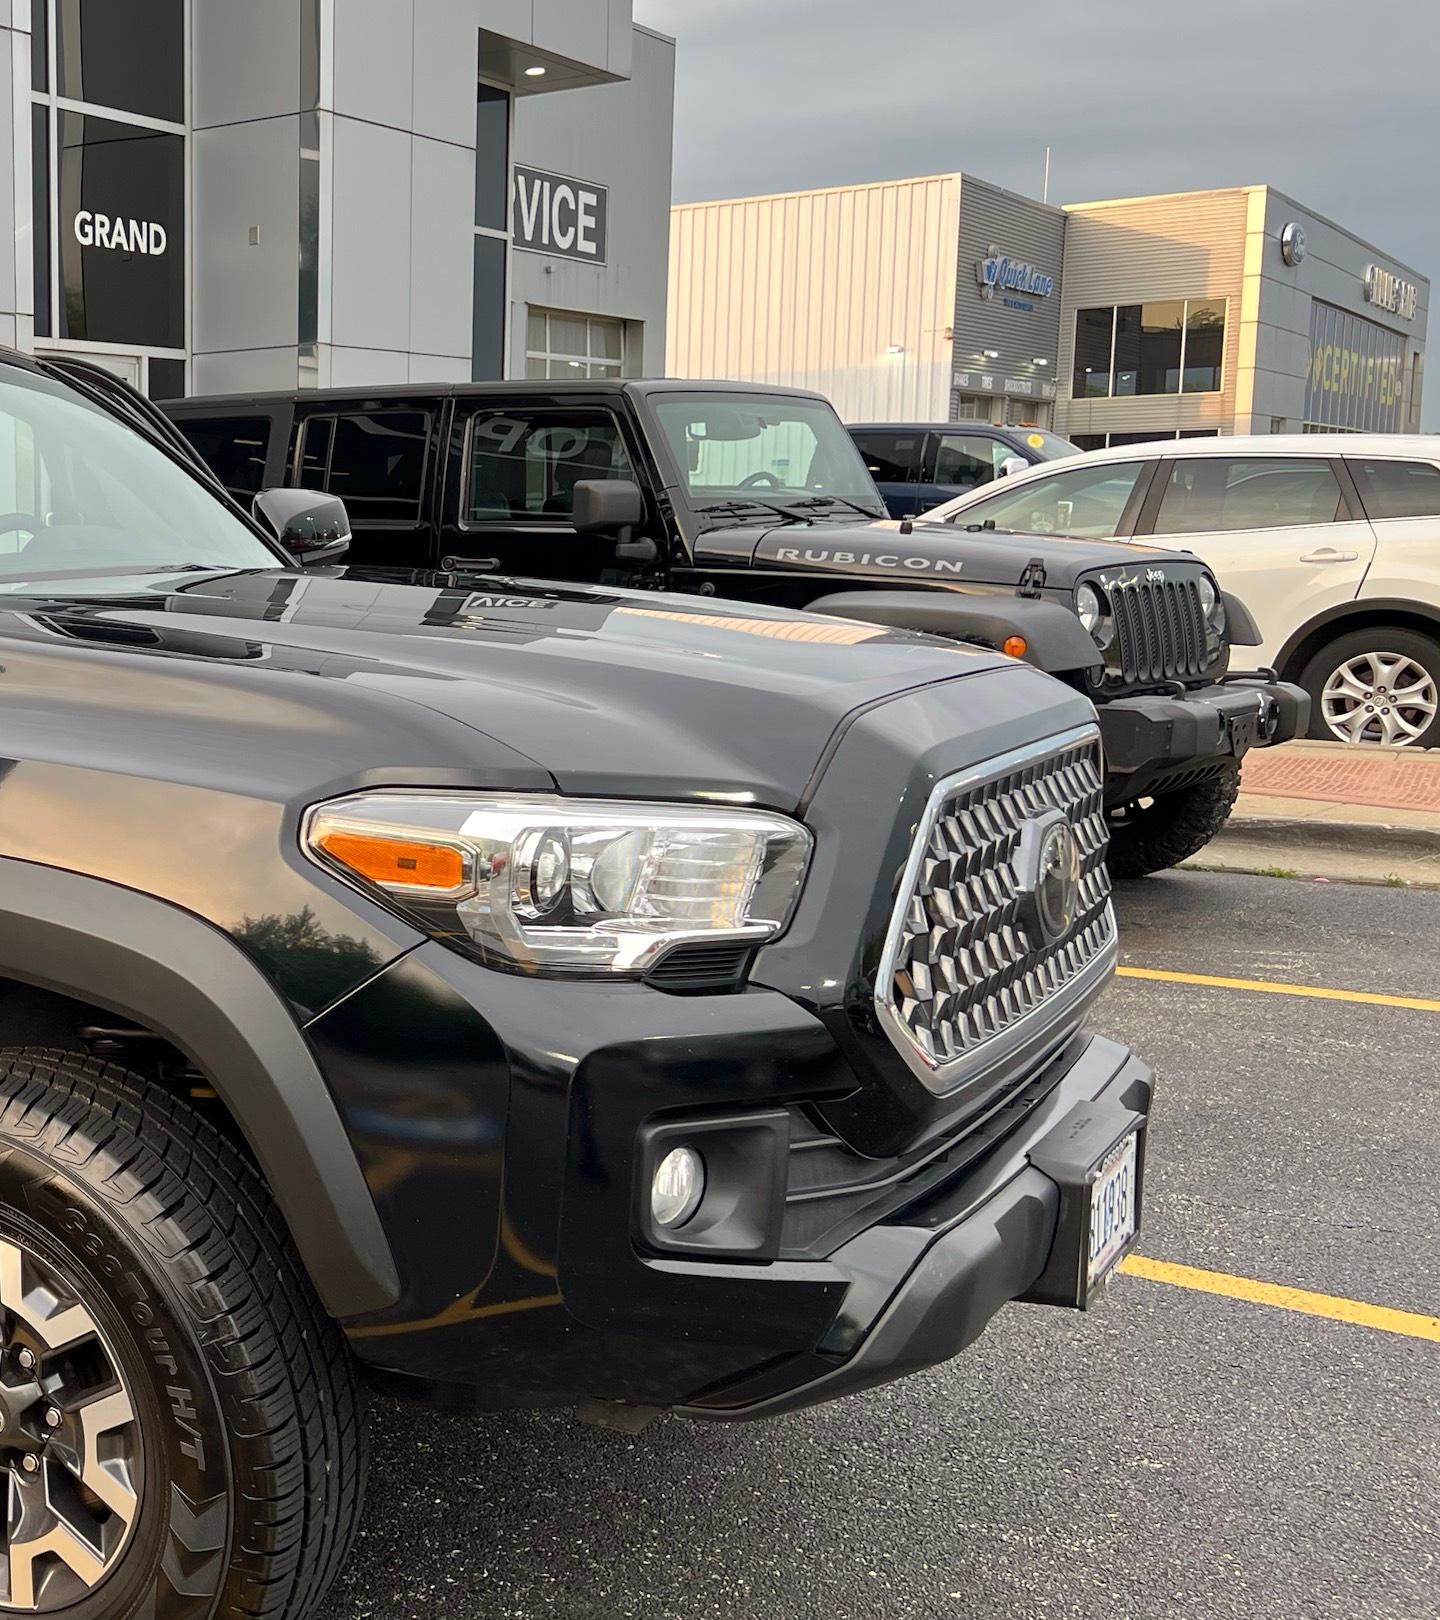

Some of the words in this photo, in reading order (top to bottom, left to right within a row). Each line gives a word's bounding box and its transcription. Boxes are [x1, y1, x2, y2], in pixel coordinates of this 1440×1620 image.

[74, 210, 167, 256] GRAND
[512, 174, 597, 255] VICE
[776, 548, 963, 573] RUBICON
[166, 1385, 206, 1471] H/T
